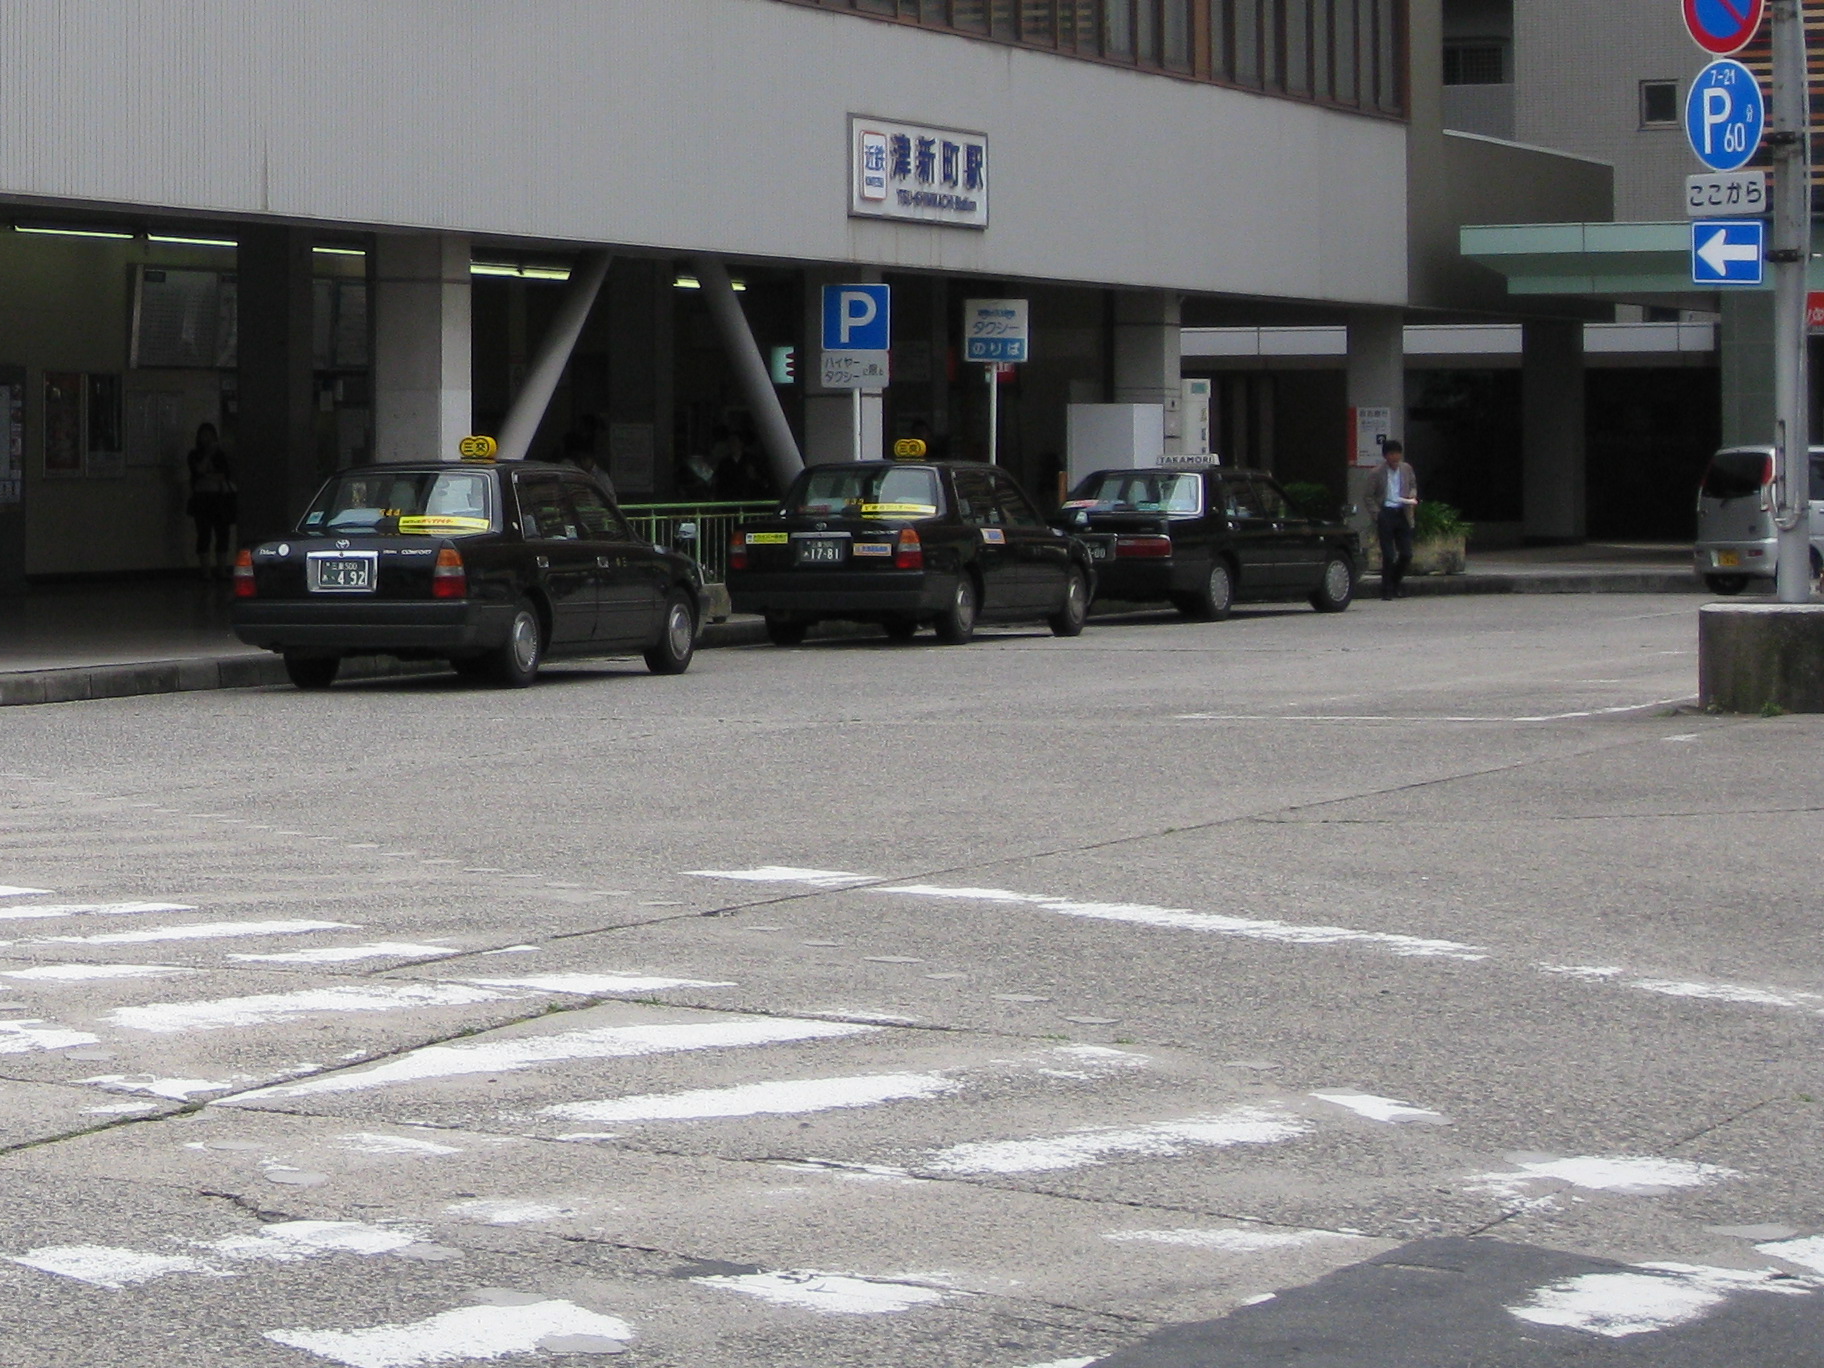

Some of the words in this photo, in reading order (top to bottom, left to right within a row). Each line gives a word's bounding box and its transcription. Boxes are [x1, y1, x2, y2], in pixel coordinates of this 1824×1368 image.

[1710, 69, 1736, 85] 7-21
[1703, 87, 1732, 154] P
[1724, 122, 1746, 152] 60
[889, 133, 984, 191] 津新町駅
[1690, 181, 1762, 207] ここから
[840, 291, 877, 343] P
[973, 321, 1020, 335] タクシー
[973, 342, 1021, 356] のりば
[825, 357, 860, 368] ハイヤー
[825, 370, 860, 383] タクシー
[1160, 456, 1213, 464] TAKAMORI
[811, 548, 839, 560] 17-81
